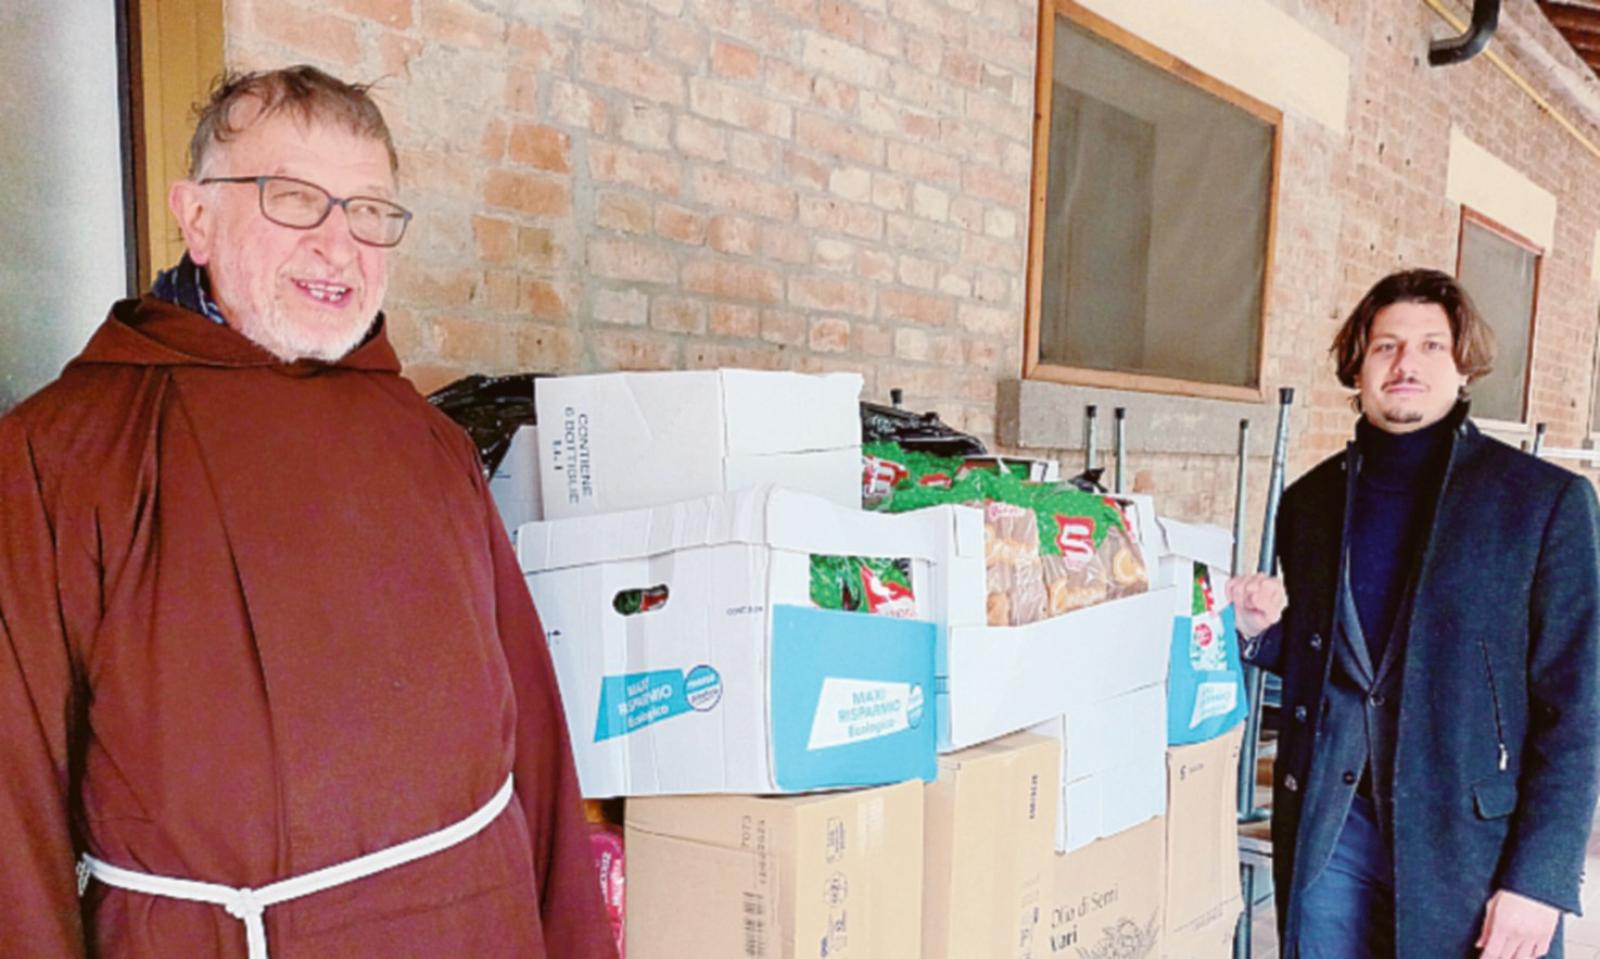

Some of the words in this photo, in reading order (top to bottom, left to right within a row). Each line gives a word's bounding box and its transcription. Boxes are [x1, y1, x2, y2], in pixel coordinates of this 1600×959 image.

[578, 413, 592, 497] CONTIENE
[852, 687, 887, 705] MAXI
[837, 699, 901, 723] RISPARMIO
